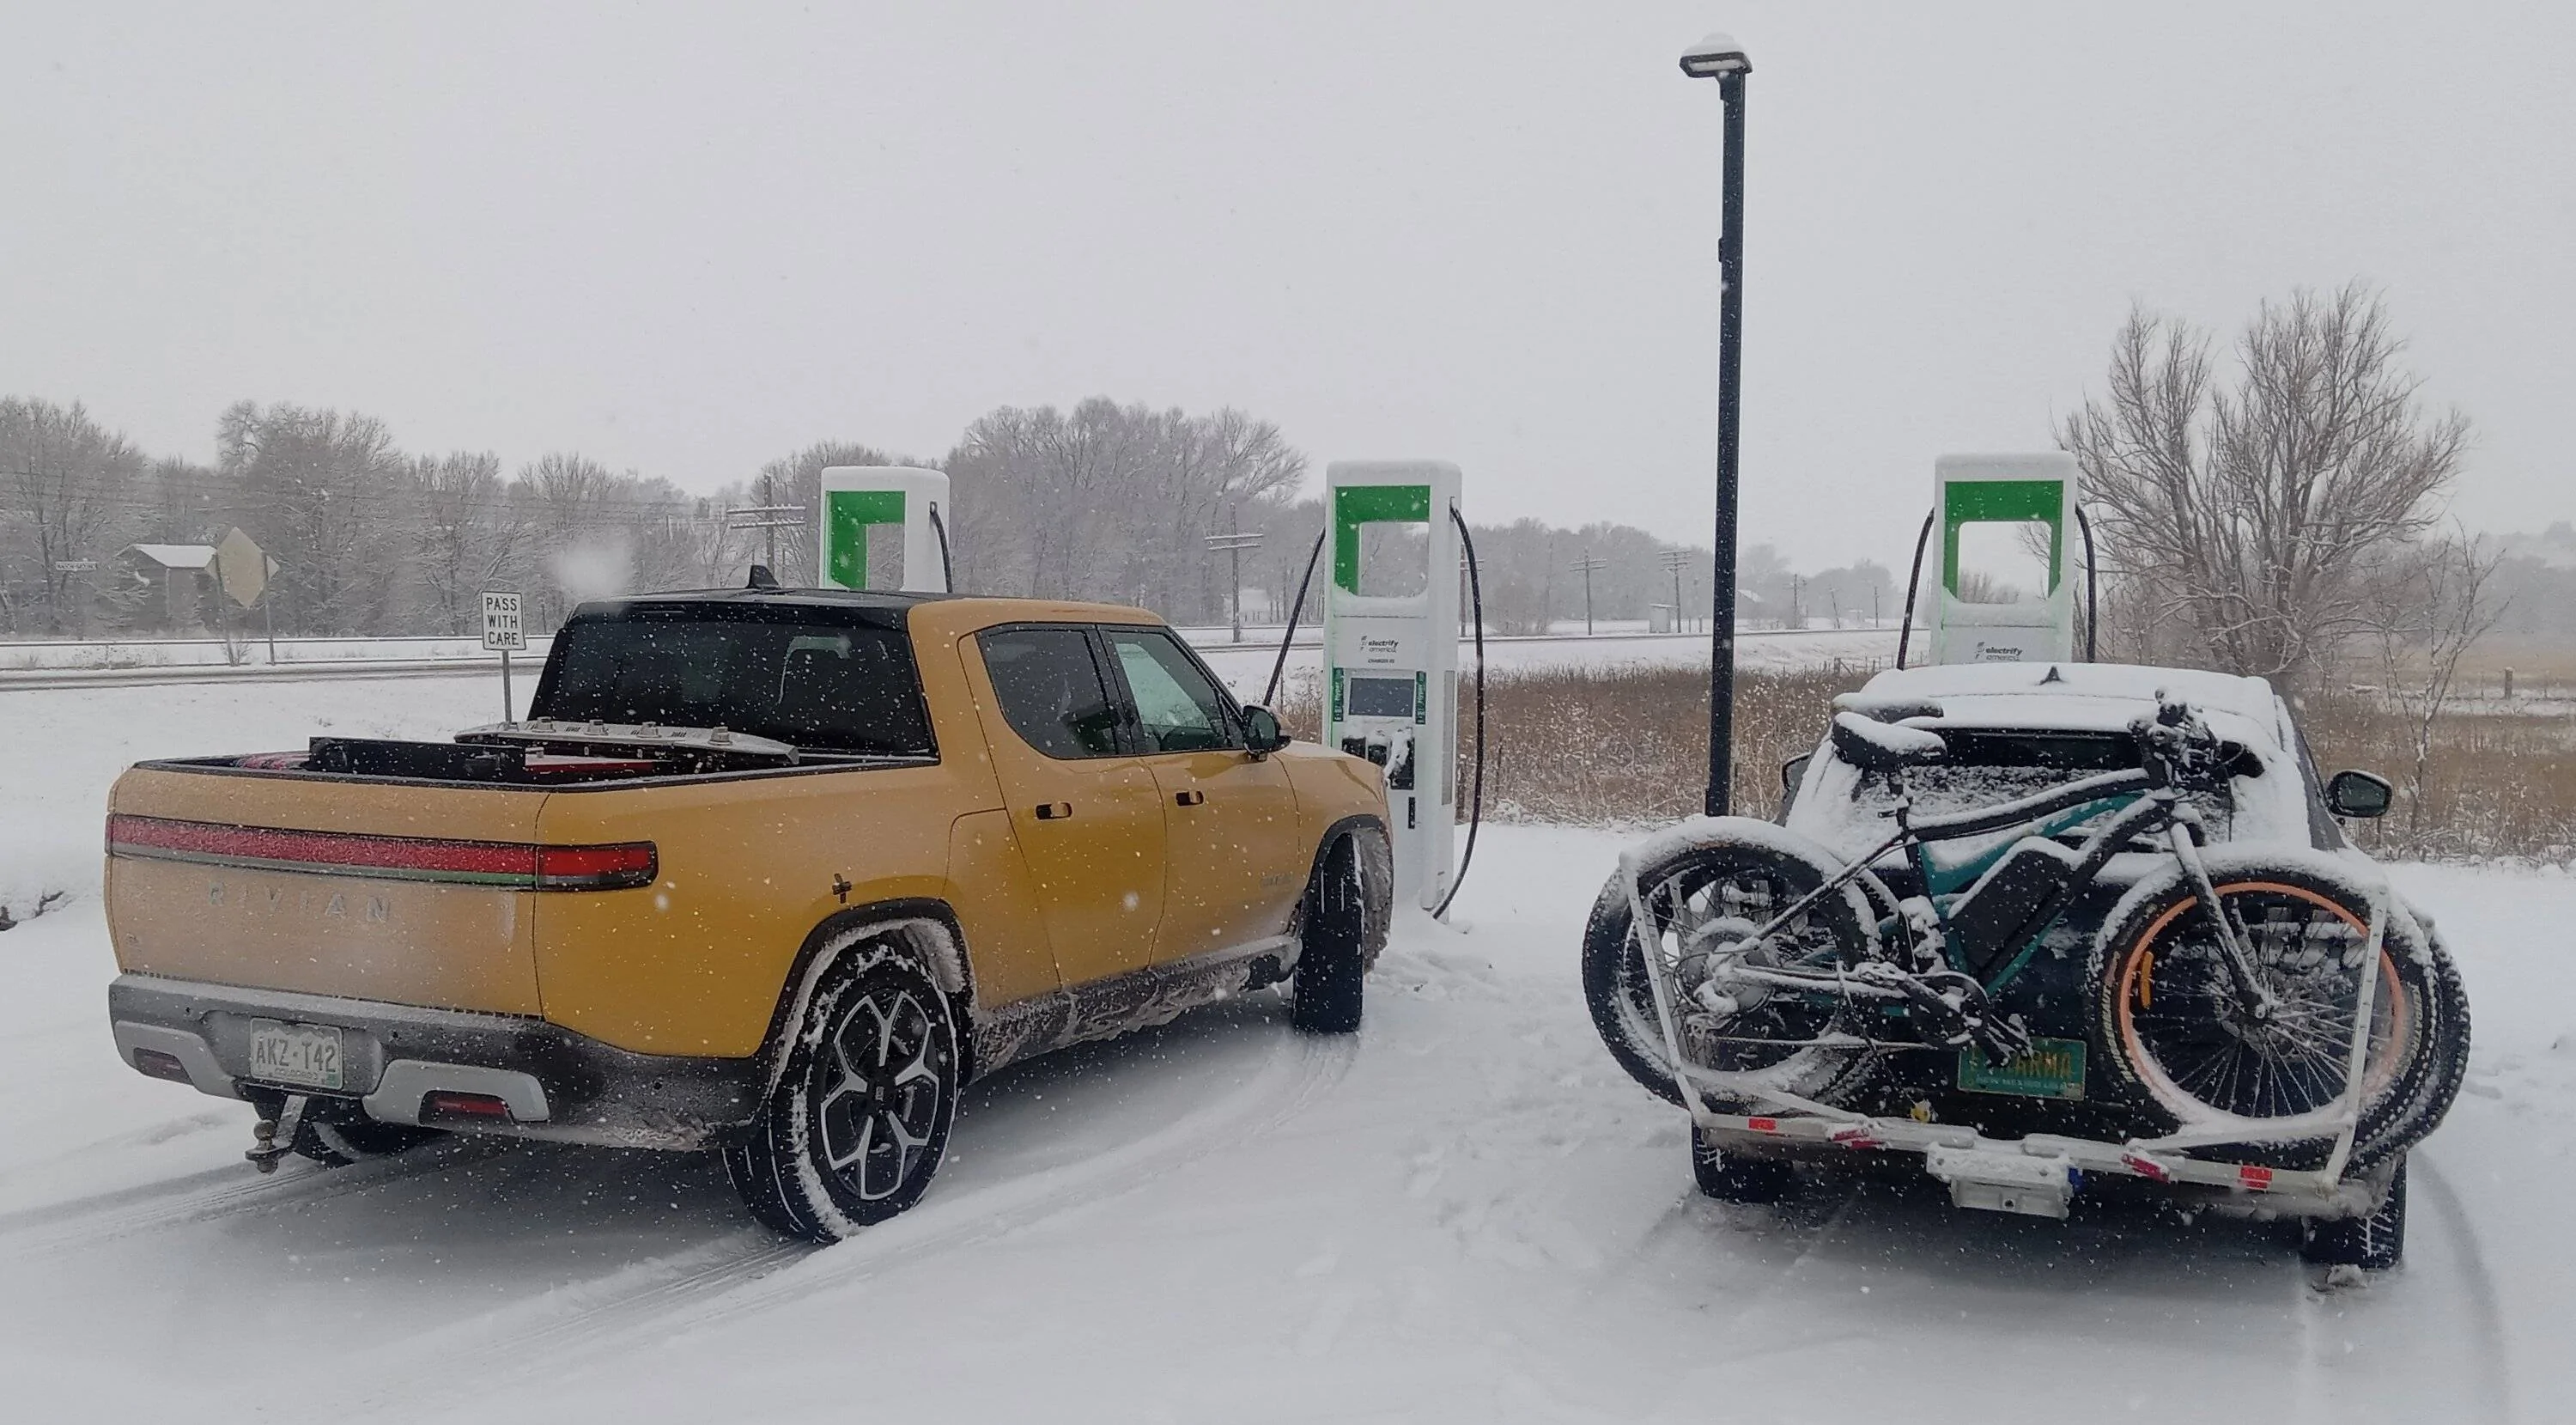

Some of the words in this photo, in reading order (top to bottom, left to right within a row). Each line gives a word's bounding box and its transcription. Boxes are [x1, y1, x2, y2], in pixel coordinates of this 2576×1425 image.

[486, 597, 517, 611] PASS
[488, 615, 518, 629] WITH
[488, 631, 519, 646] CARE
[1985, 647, 2023, 655] electrify
[210, 881, 391, 923] RIVIAN
